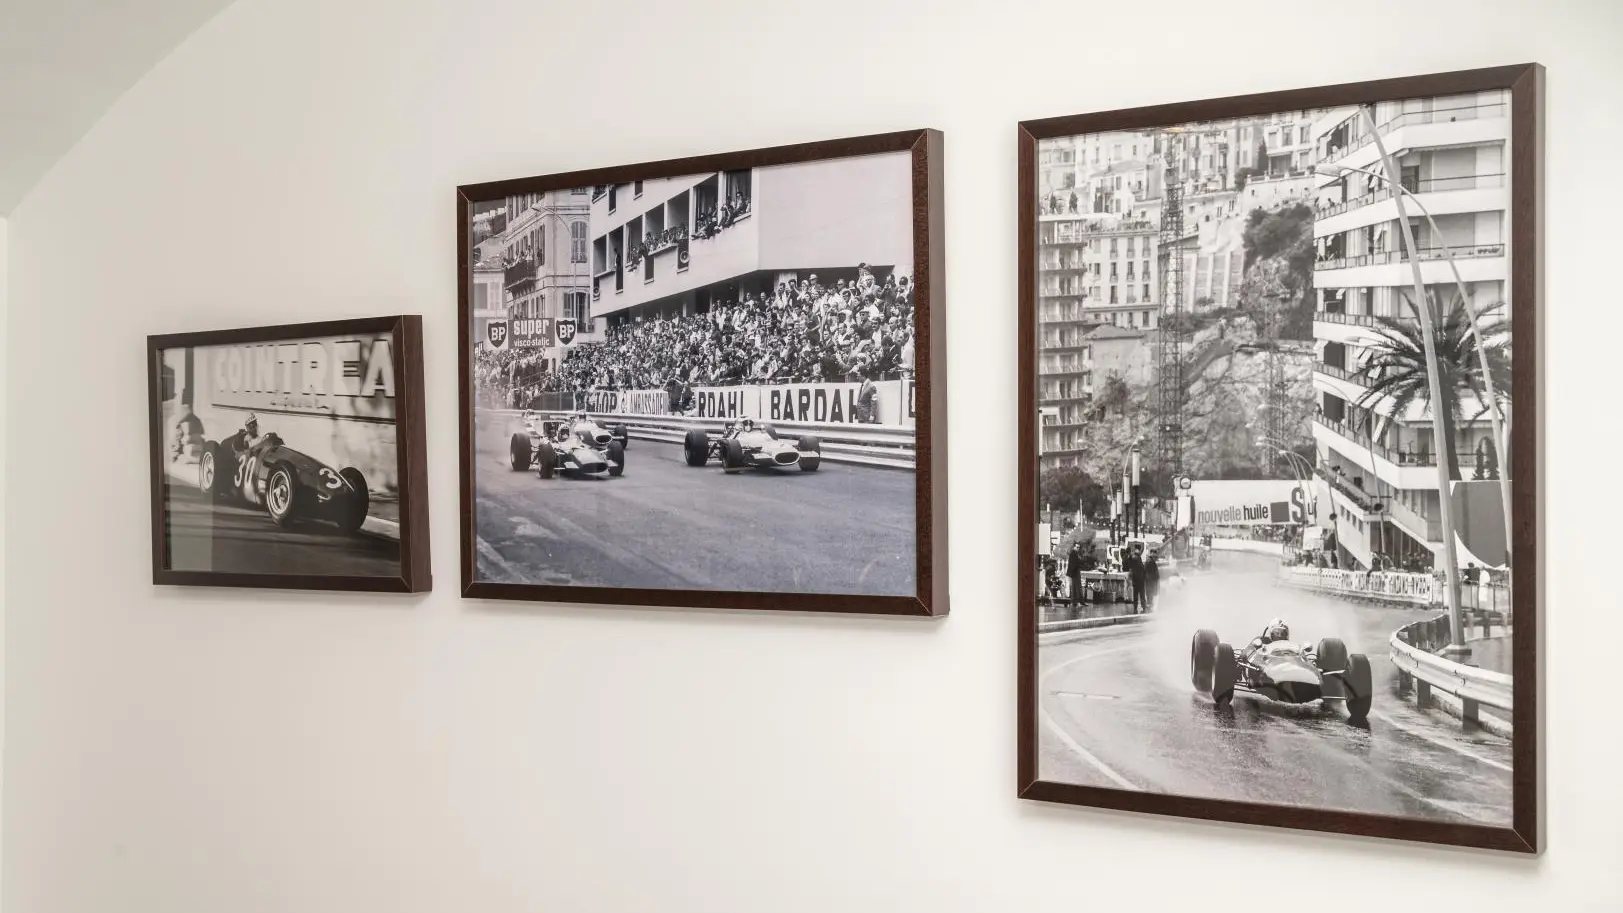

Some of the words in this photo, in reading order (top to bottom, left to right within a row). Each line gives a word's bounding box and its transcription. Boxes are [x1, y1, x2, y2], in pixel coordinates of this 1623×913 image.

[491, 326, 506, 341] BP
[513, 319, 550, 340] super
[559, 324, 575, 339] BP
[513, 337, 550, 347] visco-static
[213, 339, 396, 398] COINTREA
[699, 390, 744, 419] RDAHL
[770, 388, 859, 424] BARDAH
[234, 454, 257, 489] 30
[1198, 505, 1242, 524] nouvelle
[1243, 503, 1269, 521] huile
